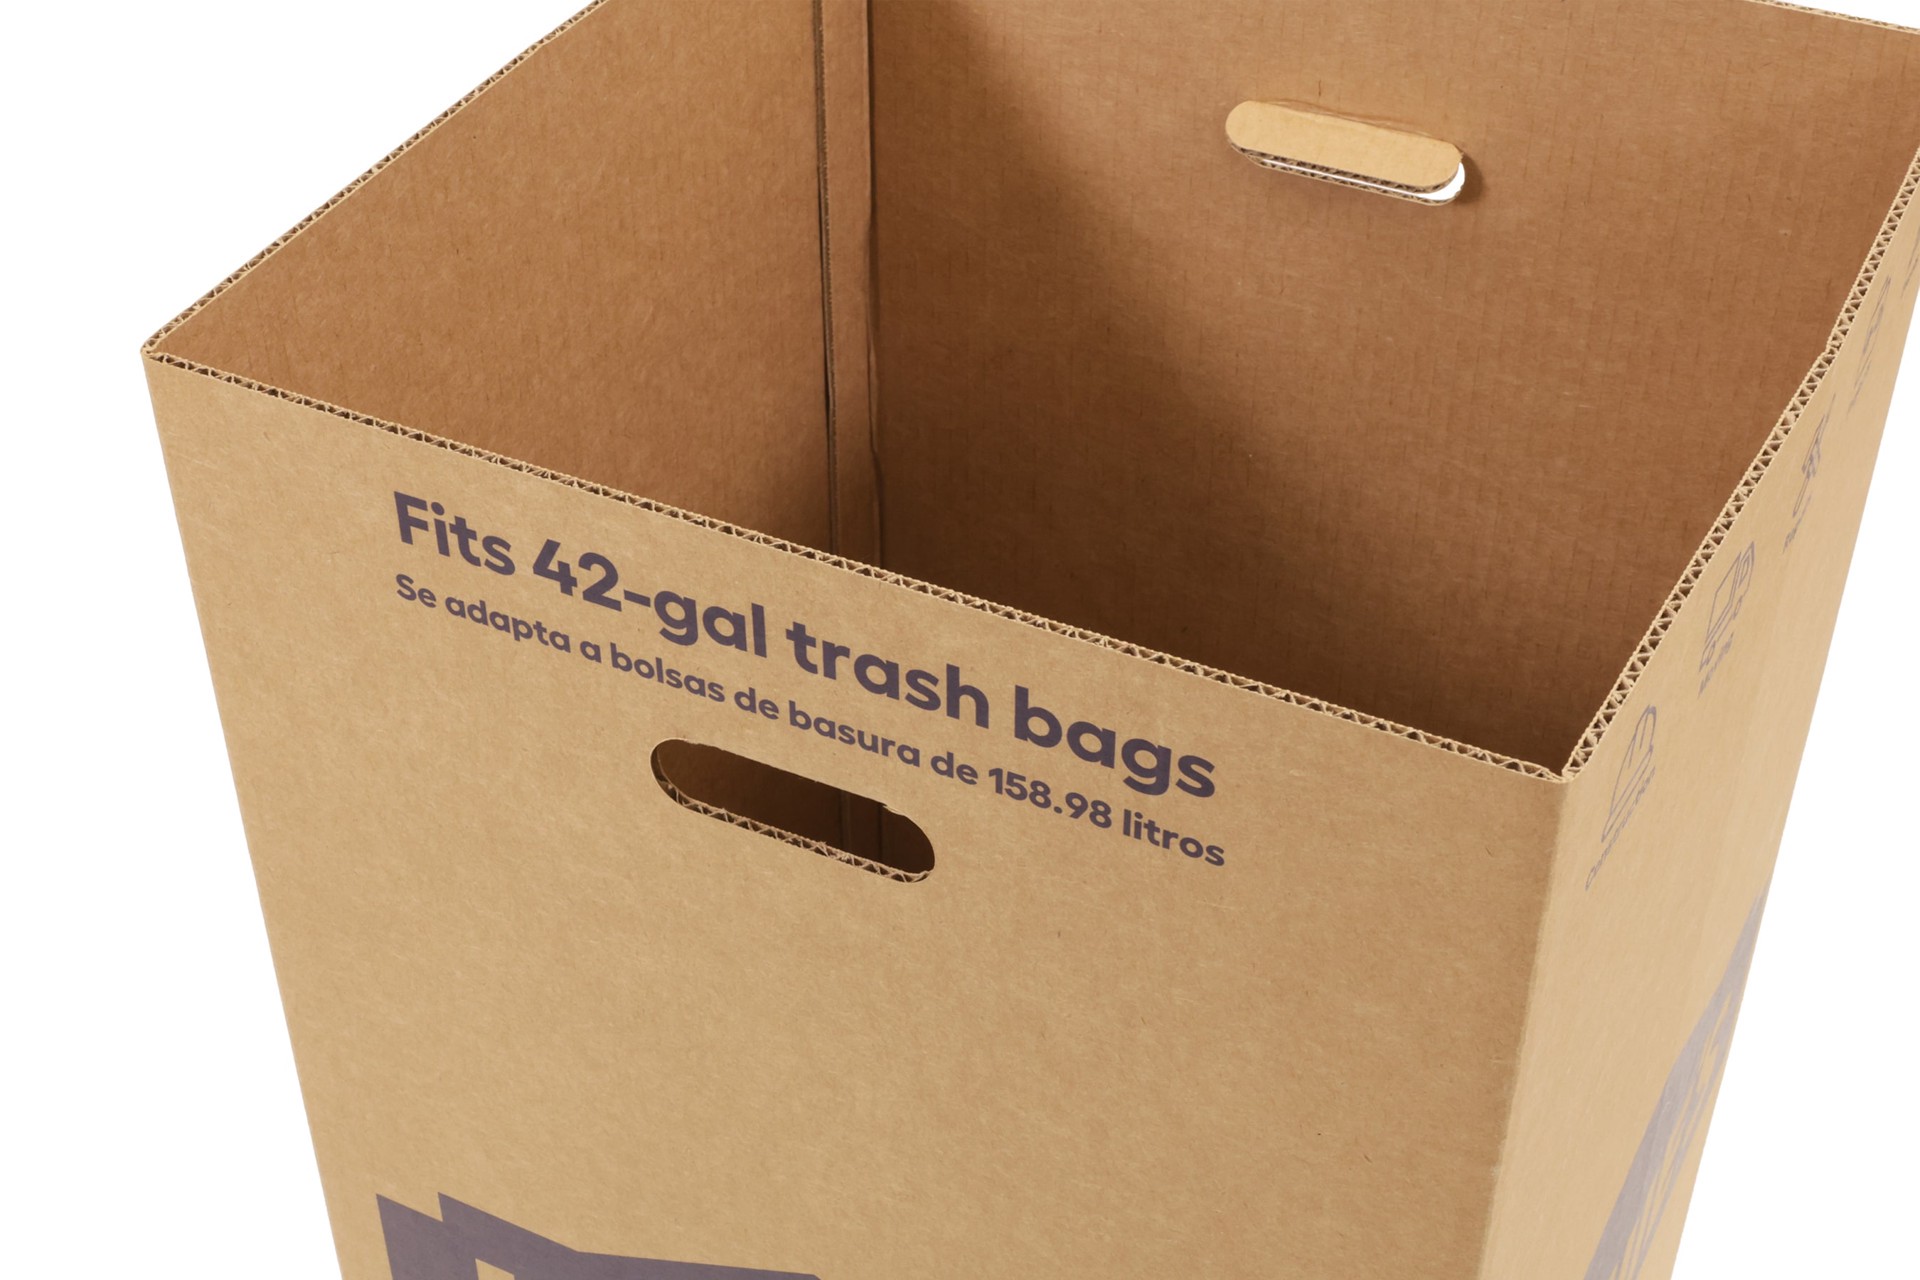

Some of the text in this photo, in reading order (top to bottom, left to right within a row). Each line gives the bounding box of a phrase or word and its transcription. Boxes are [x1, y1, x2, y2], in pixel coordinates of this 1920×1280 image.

[393, 491, 1216, 798] Fits 42-gal trash bags
[396, 574, 1226, 867] Se adapta a bolsas de basura de 158.98 litros
